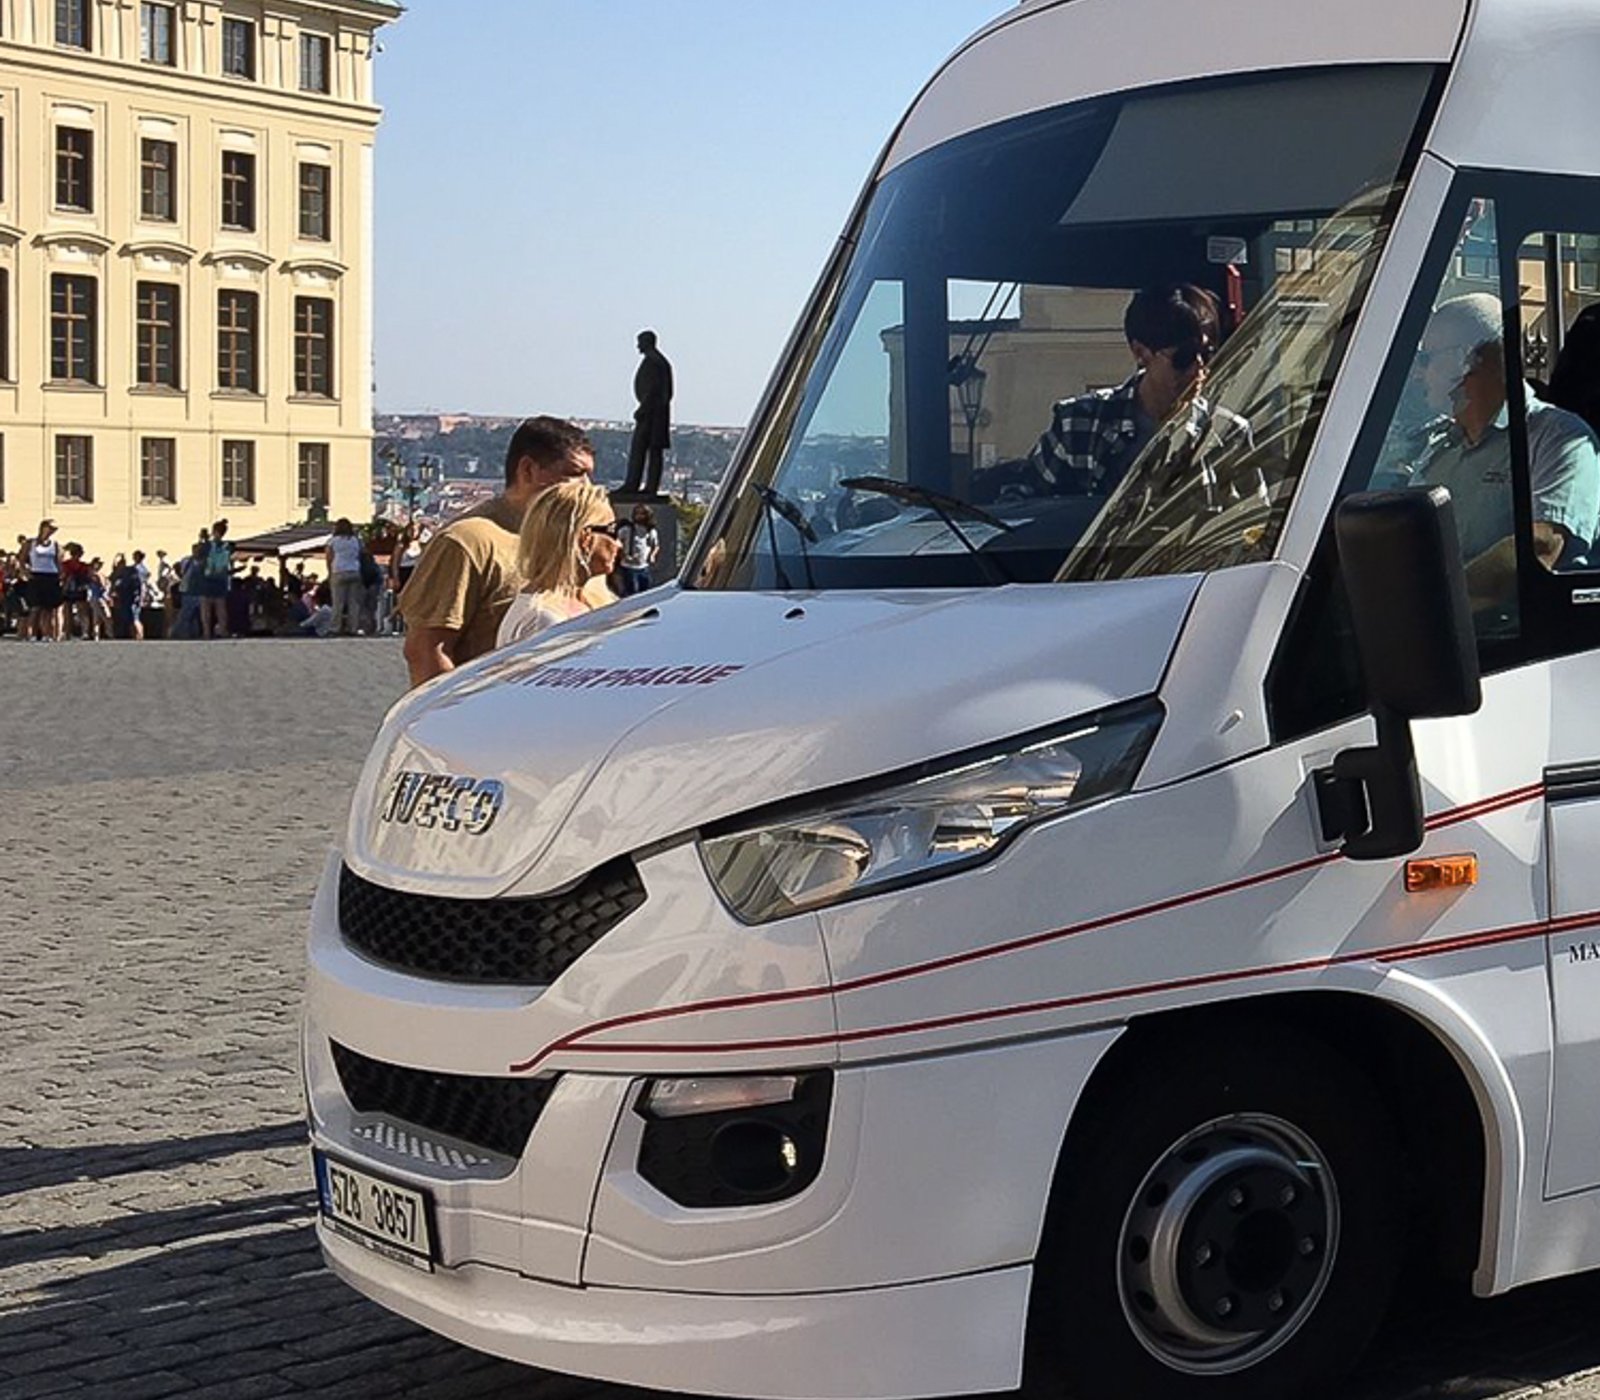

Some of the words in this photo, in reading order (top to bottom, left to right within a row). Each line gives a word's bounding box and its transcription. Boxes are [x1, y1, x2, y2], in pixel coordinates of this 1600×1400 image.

[587, 665, 745, 688] PRAGUE
[382, 771, 504, 834] IVECO
[371, 1184, 416, 1242] 3857
